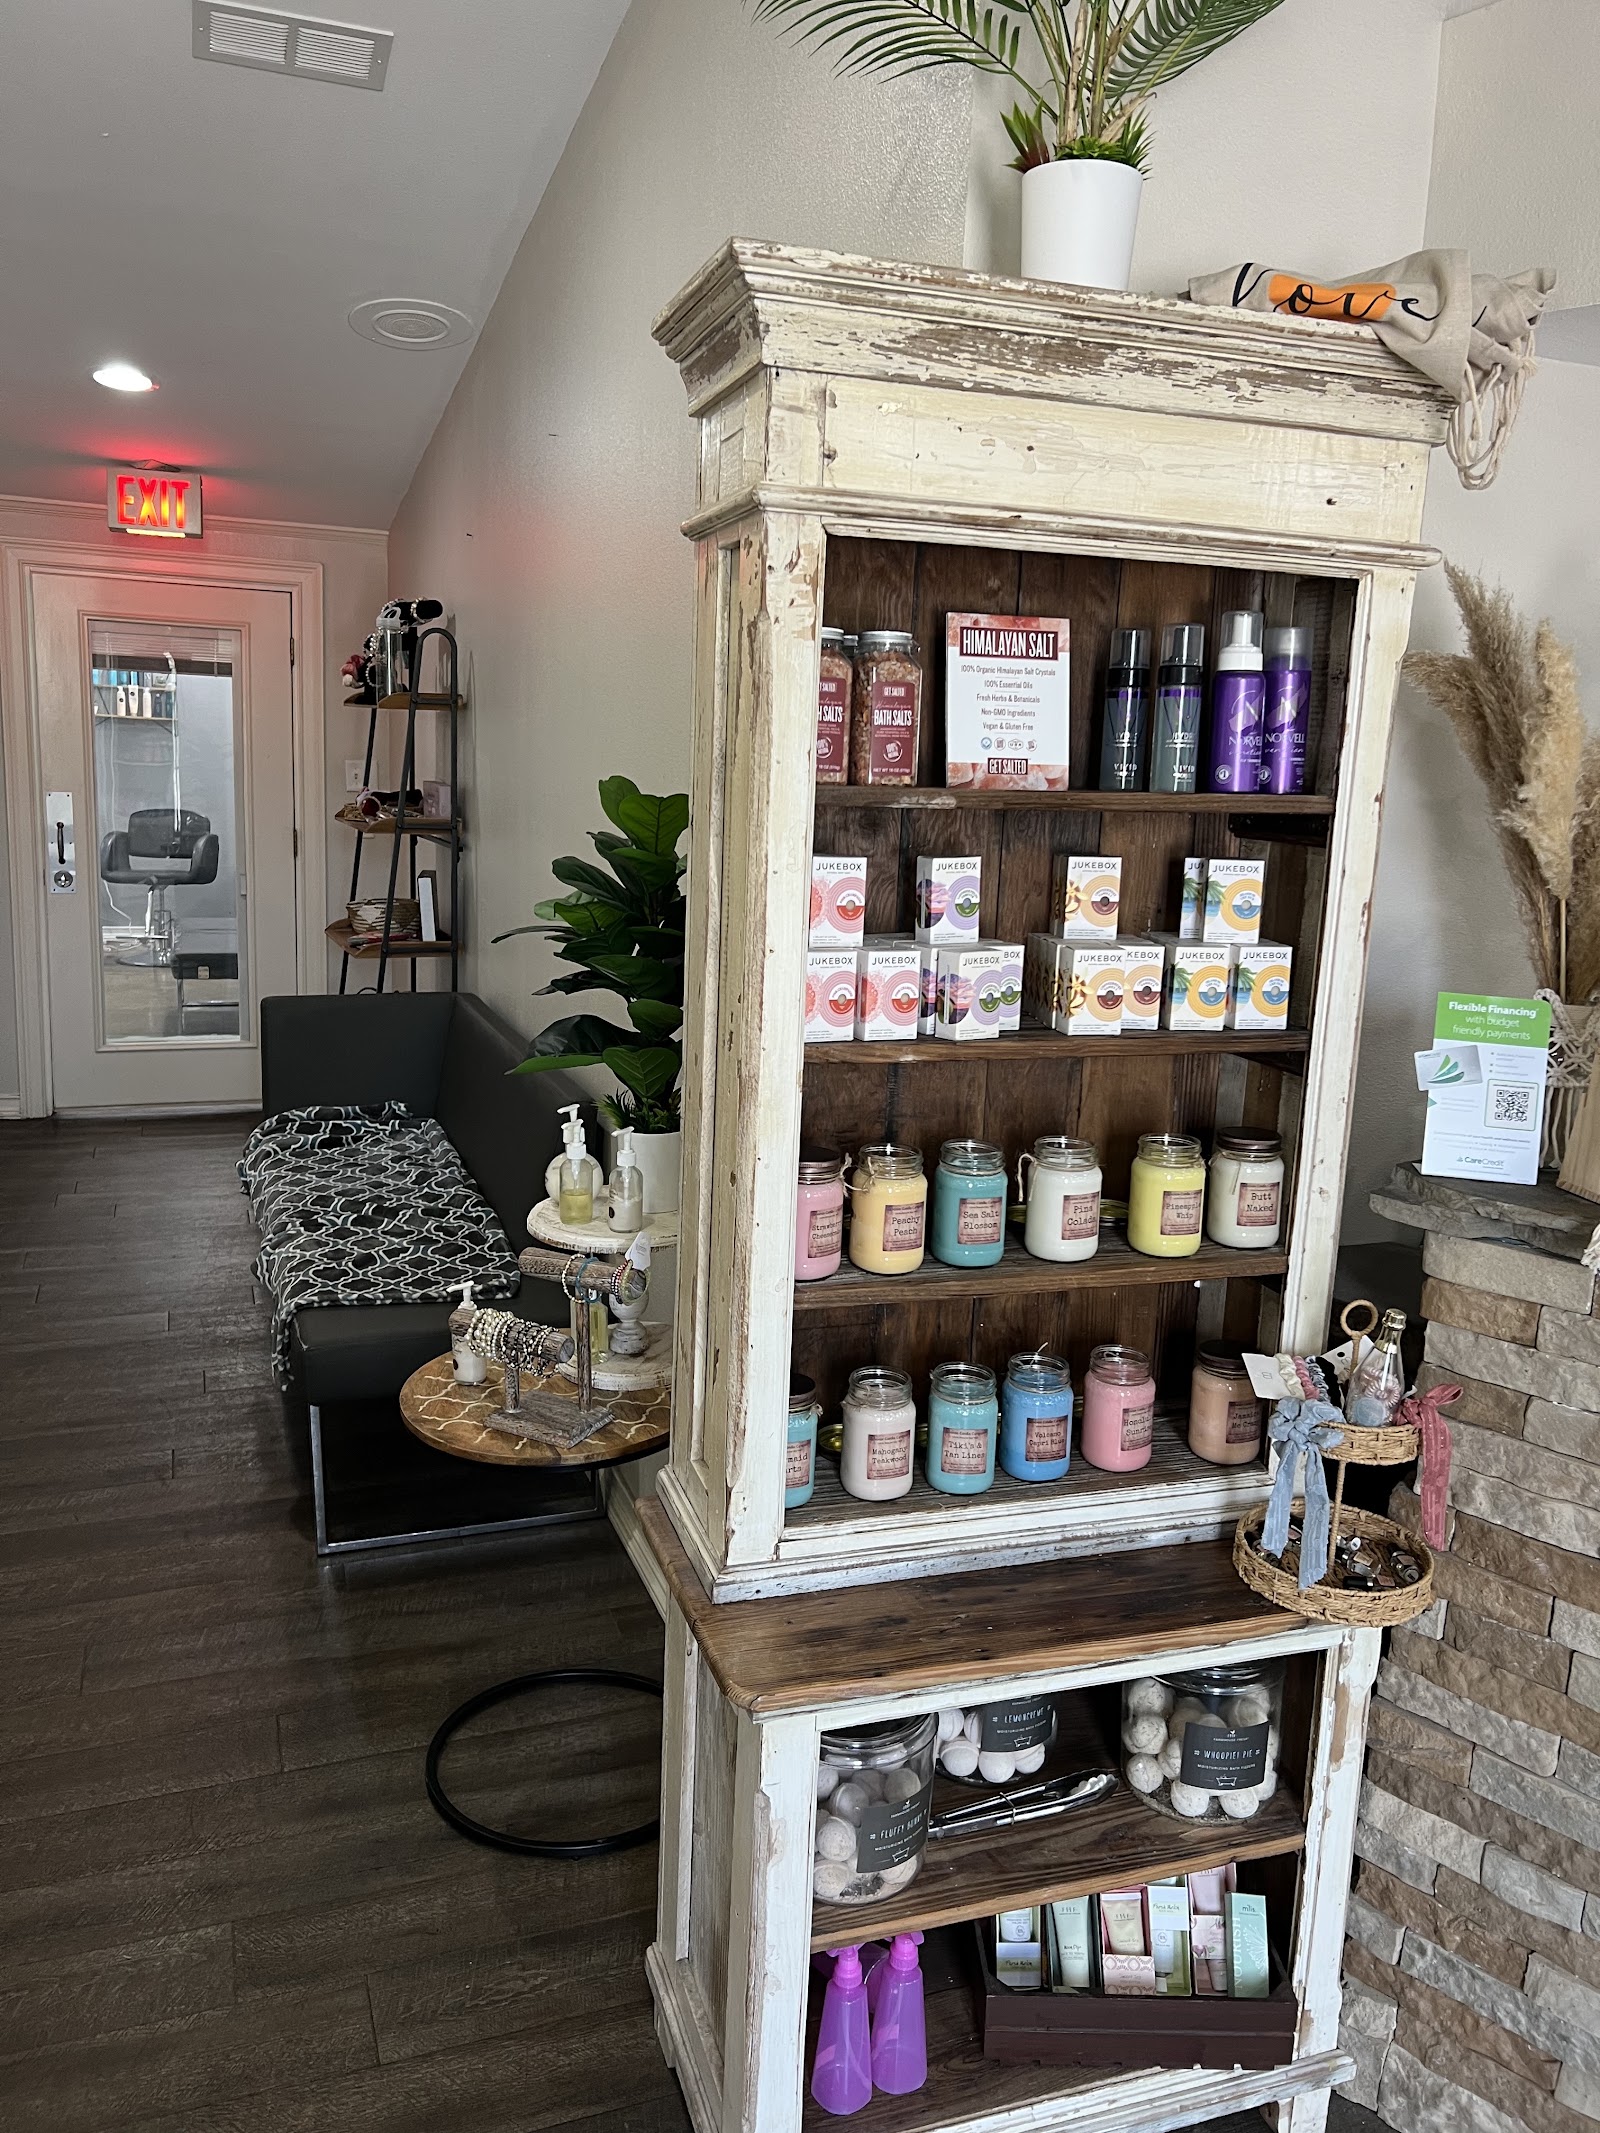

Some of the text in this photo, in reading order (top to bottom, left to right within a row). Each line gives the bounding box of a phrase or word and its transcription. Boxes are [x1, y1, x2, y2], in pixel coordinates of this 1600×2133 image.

[117, 475, 191, 528] EXIT
[963, 629, 1055, 658] HIMALAYAN SALT
[961, 664, 1056, 677] 100% Organic Himalayan Salt Crystals
[984, 680, 1033, 689] 100% Essential Oils
[976, 693, 1041, 703] Fresh Herbs & Botanicals
[823, 706, 843, 723] SALTS
[874, 709, 912, 726] BATH SALTS
[981, 708, 1036, 718] Non-GMO Ingredients
[982, 722, 1034, 731] Vegan & Gluten Free
[1265, 732, 1305, 743] NOVELL
[989, 759, 1027, 775] GET SALTED
[1114, 763, 1137, 771] VIVID
[1173, 765, 1195, 773] VIVID
[816, 862, 862, 871] JUKEBOX
[936, 862, 978, 871] JUKEBOX
[1072, 862, 1117, 870] JUKEBOX
[1212, 865, 1260, 873] JUKEBOX
[1078, 954, 1122, 963] JUKEBOX
[1127, 951, 1160, 959] KEBOX
[1179, 952, 1225, 960] JUKEBOX
[1243, 952, 1288, 960] JUKEBOX
[809, 957, 853, 966] JUKEBOX
[872, 956, 916, 966] JUKEBOX
[963, 956, 1000, 966] JUKEBOX
[1449, 1001, 1537, 1019] Flexible Financing
[1465, 1015, 1485, 1024] with
[1452, 1024, 1531, 1040] friendly payments
[1464, 1156, 1504, 1167] CareCredit
[1250, 1192, 1272, 1201] Butt
[1165, 1202, 1201, 1211] Pineapple
[1246, 1204, 1274, 1212] Naked
[963, 1210, 999, 1219] Sea Salt
[1176, 1212, 1194, 1220] Whip
[891, 1216, 920, 1225] Peachy
[1067, 1216, 1096, 1226] Colada
[812, 1221, 842, 1231] Strawberr
[963, 1221, 998, 1230] Blossom
[894, 1227, 918, 1236] Peach
[1035, 1431, 1061, 1439] Volcano
[948, 1440, 975, 1450] Tiki's
[1029, 1438, 1065, 1447] Capri Blue
[872, 1445, 908, 1455] Mahogany
[944, 1450, 985, 1459] Tan Lines
[787, 1453, 808, 1463] maid
[872, 1454, 907, 1464] Teakwood
[1242, 1749, 1253, 1758] PIE
[1197, 1763, 1229, 1771] MOISTURIZING
[880, 1823, 905, 1839] FLUFFY
[1232, 1917, 1243, 1989] NOURISH
